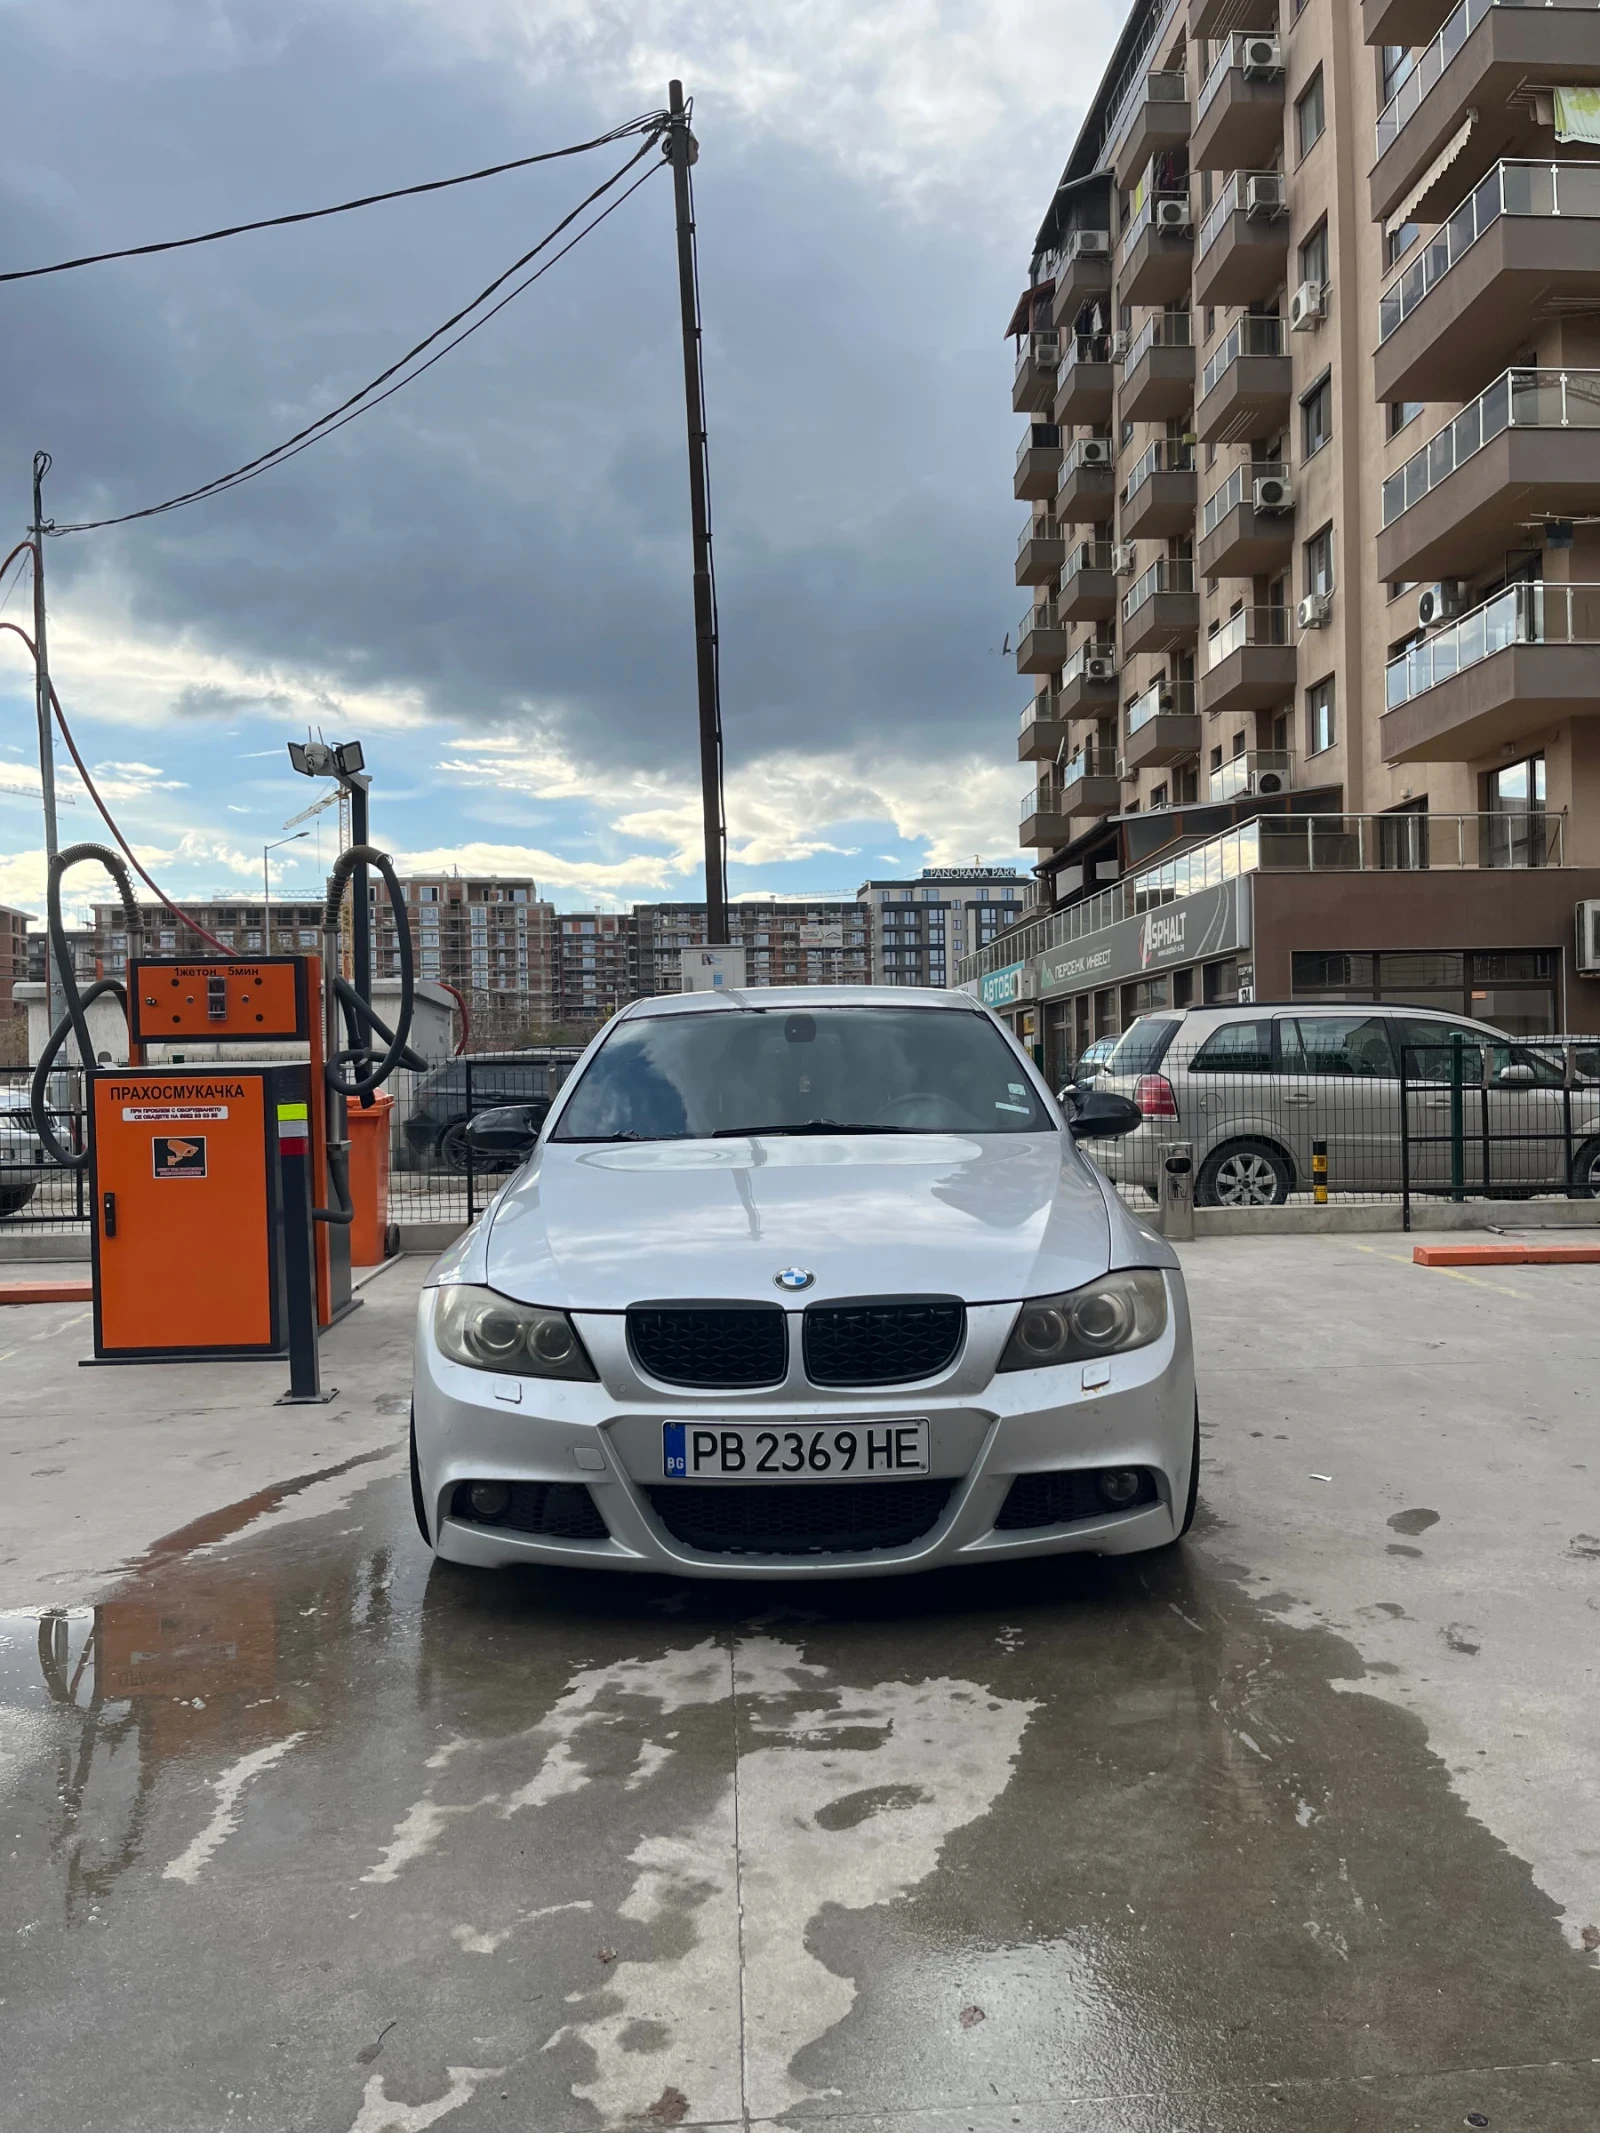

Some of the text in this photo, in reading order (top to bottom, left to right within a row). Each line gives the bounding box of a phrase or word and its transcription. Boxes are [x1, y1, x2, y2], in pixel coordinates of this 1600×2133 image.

[930, 867, 1016, 877] PANORAMA PARK
[1141, 911, 1187, 970] ASPHALT
[228, 966, 259, 976] 5мин
[1055, 949, 1112, 979] ПЕРСЕНК ИНВЕСТ
[110, 1084, 245, 1100] ПРАХОСМУКАЧКА
[692, 1427, 921, 1472] PB 2369 HE
[667, 1457, 684, 1469] BG
